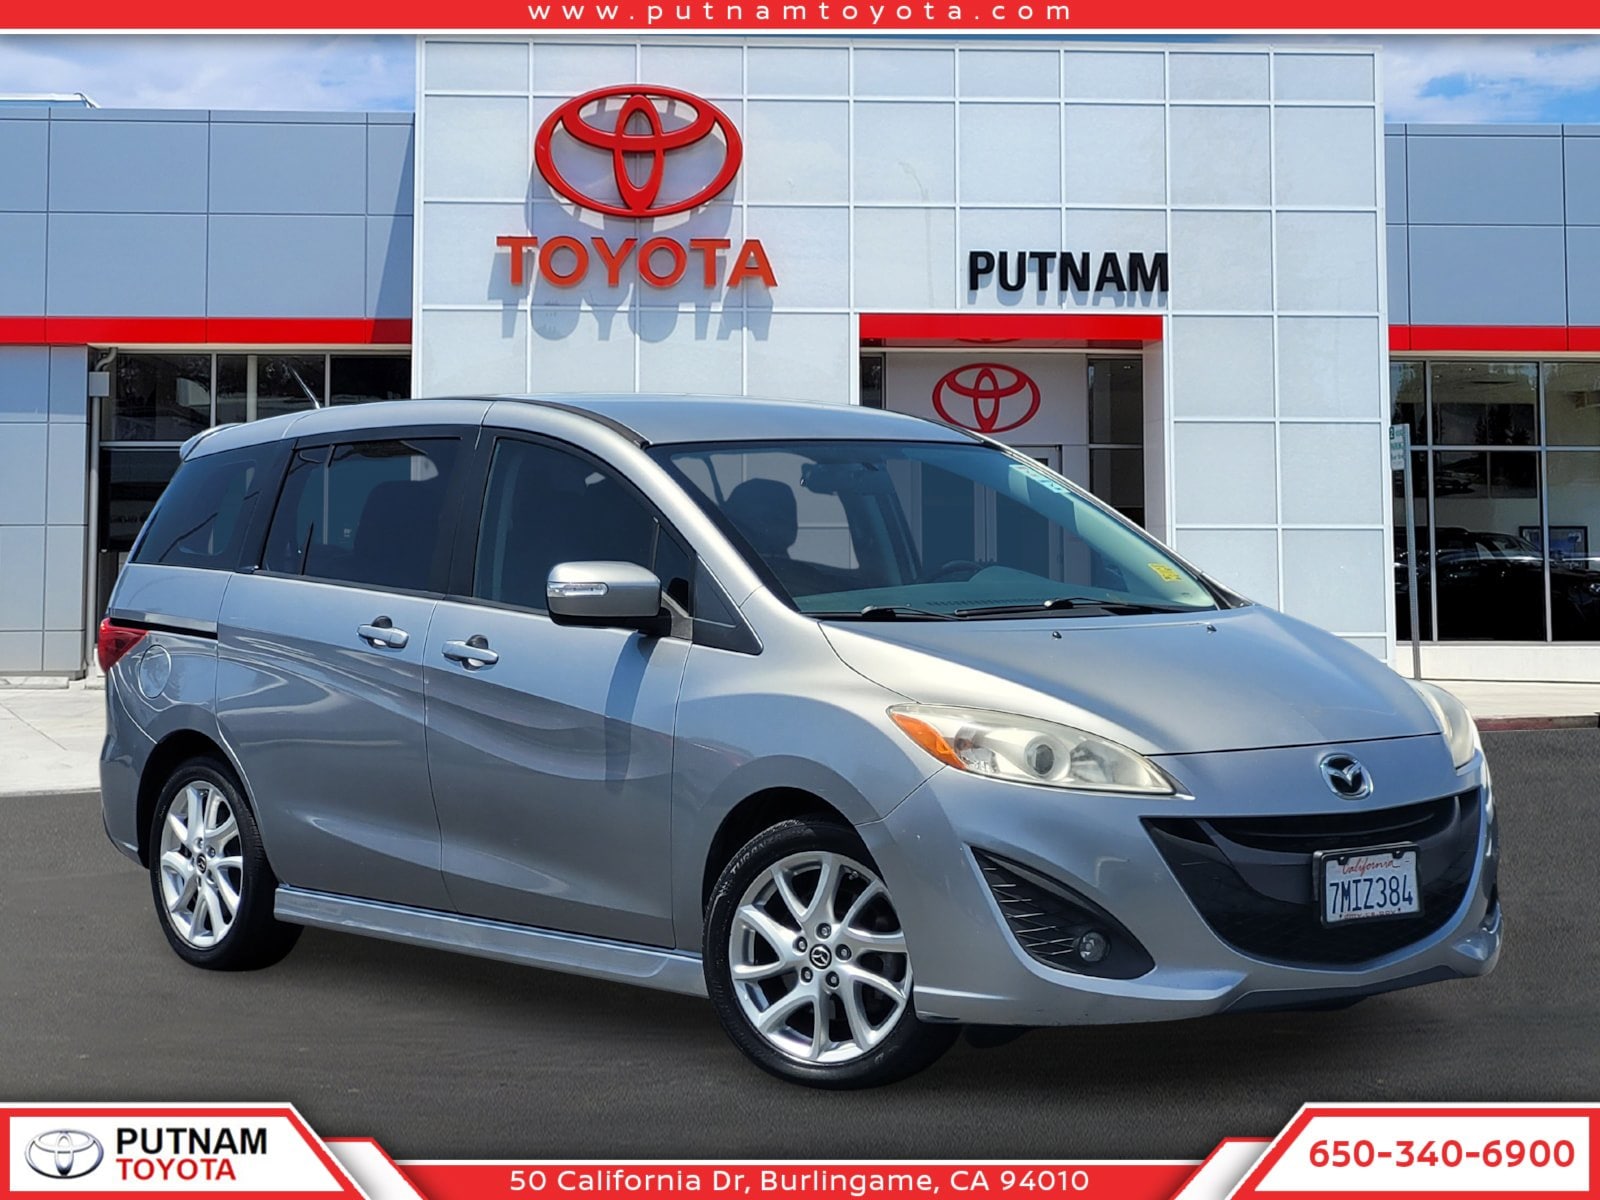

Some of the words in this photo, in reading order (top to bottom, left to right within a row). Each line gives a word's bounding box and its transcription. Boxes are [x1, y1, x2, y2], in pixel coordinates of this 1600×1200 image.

[496, 236, 778, 288] TOYOTA
[969, 251, 1169, 293] PUTNAM
[1329, 874, 1413, 914] 7MIZ384
